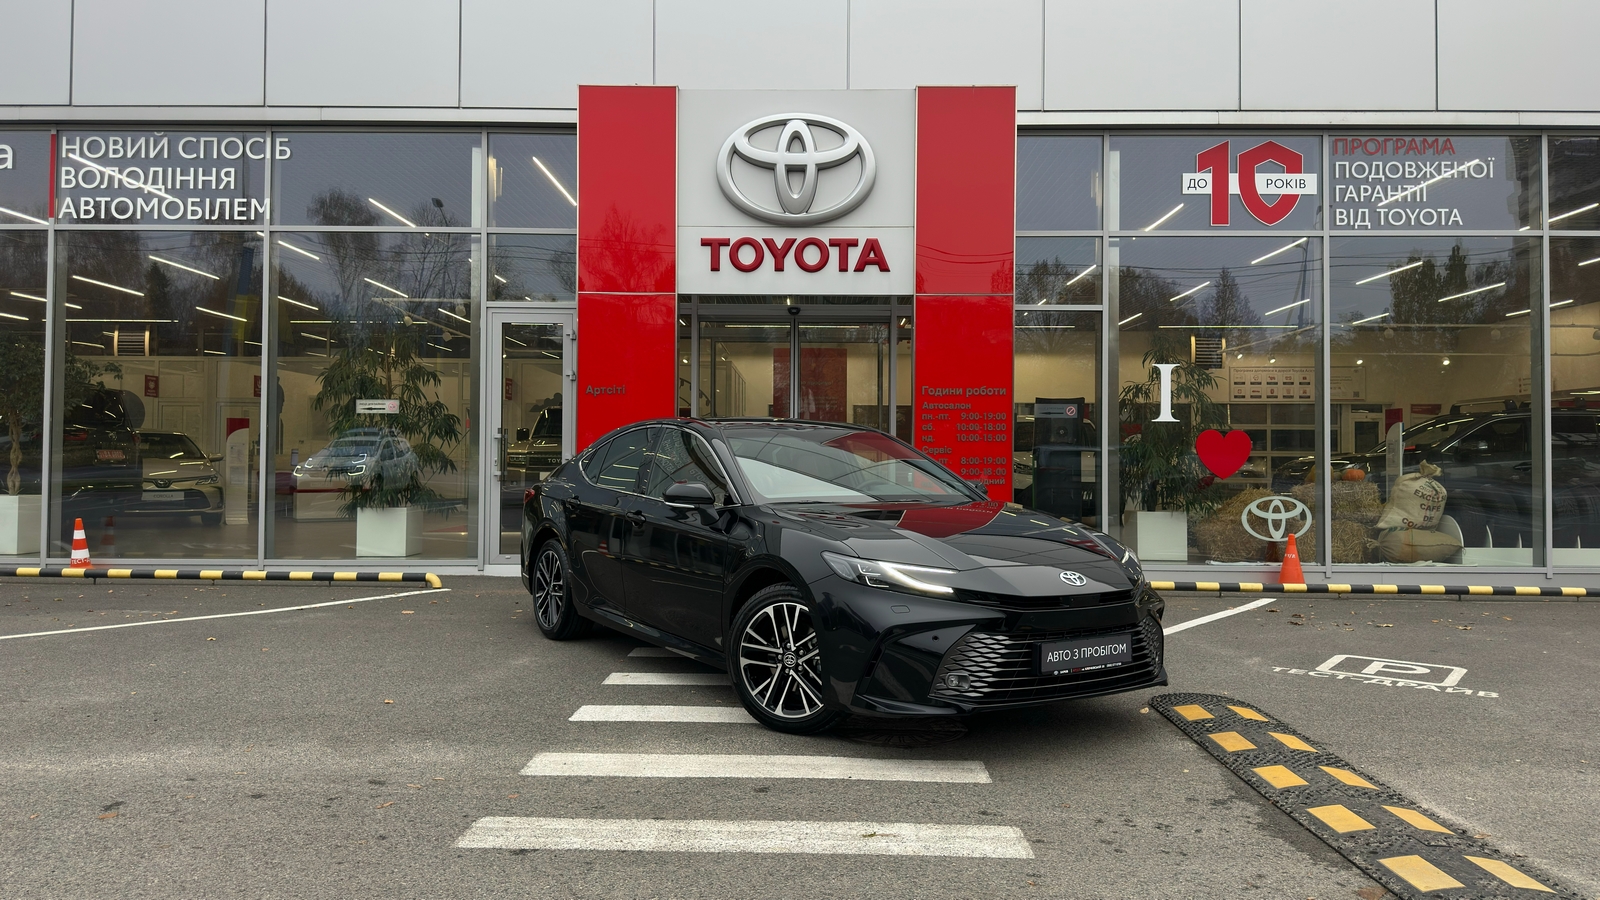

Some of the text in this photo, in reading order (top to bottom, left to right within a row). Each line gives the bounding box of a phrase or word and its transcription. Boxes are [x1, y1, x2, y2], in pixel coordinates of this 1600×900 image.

[61, 131, 291, 160] НОВИЙ СПОСІБ
[1333, 137, 1456, 156] ПРОГРАМА
[1335, 157, 1495, 181] ПОДОВЖЕНОЇ
[60, 166, 236, 194] ВОЛОДІННЯ
[1187, 139, 1307, 226] ДО 10 РОКІВ
[1335, 181, 1428, 203] ГАРАНТІЇ
[58, 197, 271, 221] АВТОМОБІЛЕМ
[1335, 208, 1463, 229] ВІД TOYOTA
[700, 236, 891, 273] TOYOTA
[585, 384, 626, 397] Артсіті
[921, 386, 1007, 398] Години роботи
[1151, 363, 1180, 422] I
[922, 401, 972, 410] Автосалон
[921, 412, 1007, 420] пн.-пт. 9:00-19:00
[921, 422, 1007, 431] сб. 10:00-18:00
[921, 433, 1007, 443] нд. 10:00-15:00
[921, 445, 952, 455] Сервіс
[960, 457, 1007, 465] 8:00-19:00
[960, 467, 1007, 476] 9:00-18:00
[1422, 515, 1435, 523] DE
[1047, 643, 1127, 662] АВТО З ПРОБІГОМ
[1360, 660, 1431, 675] P
[1271, 666, 1500, 698] ТЕСТ-ДРАЙВ
